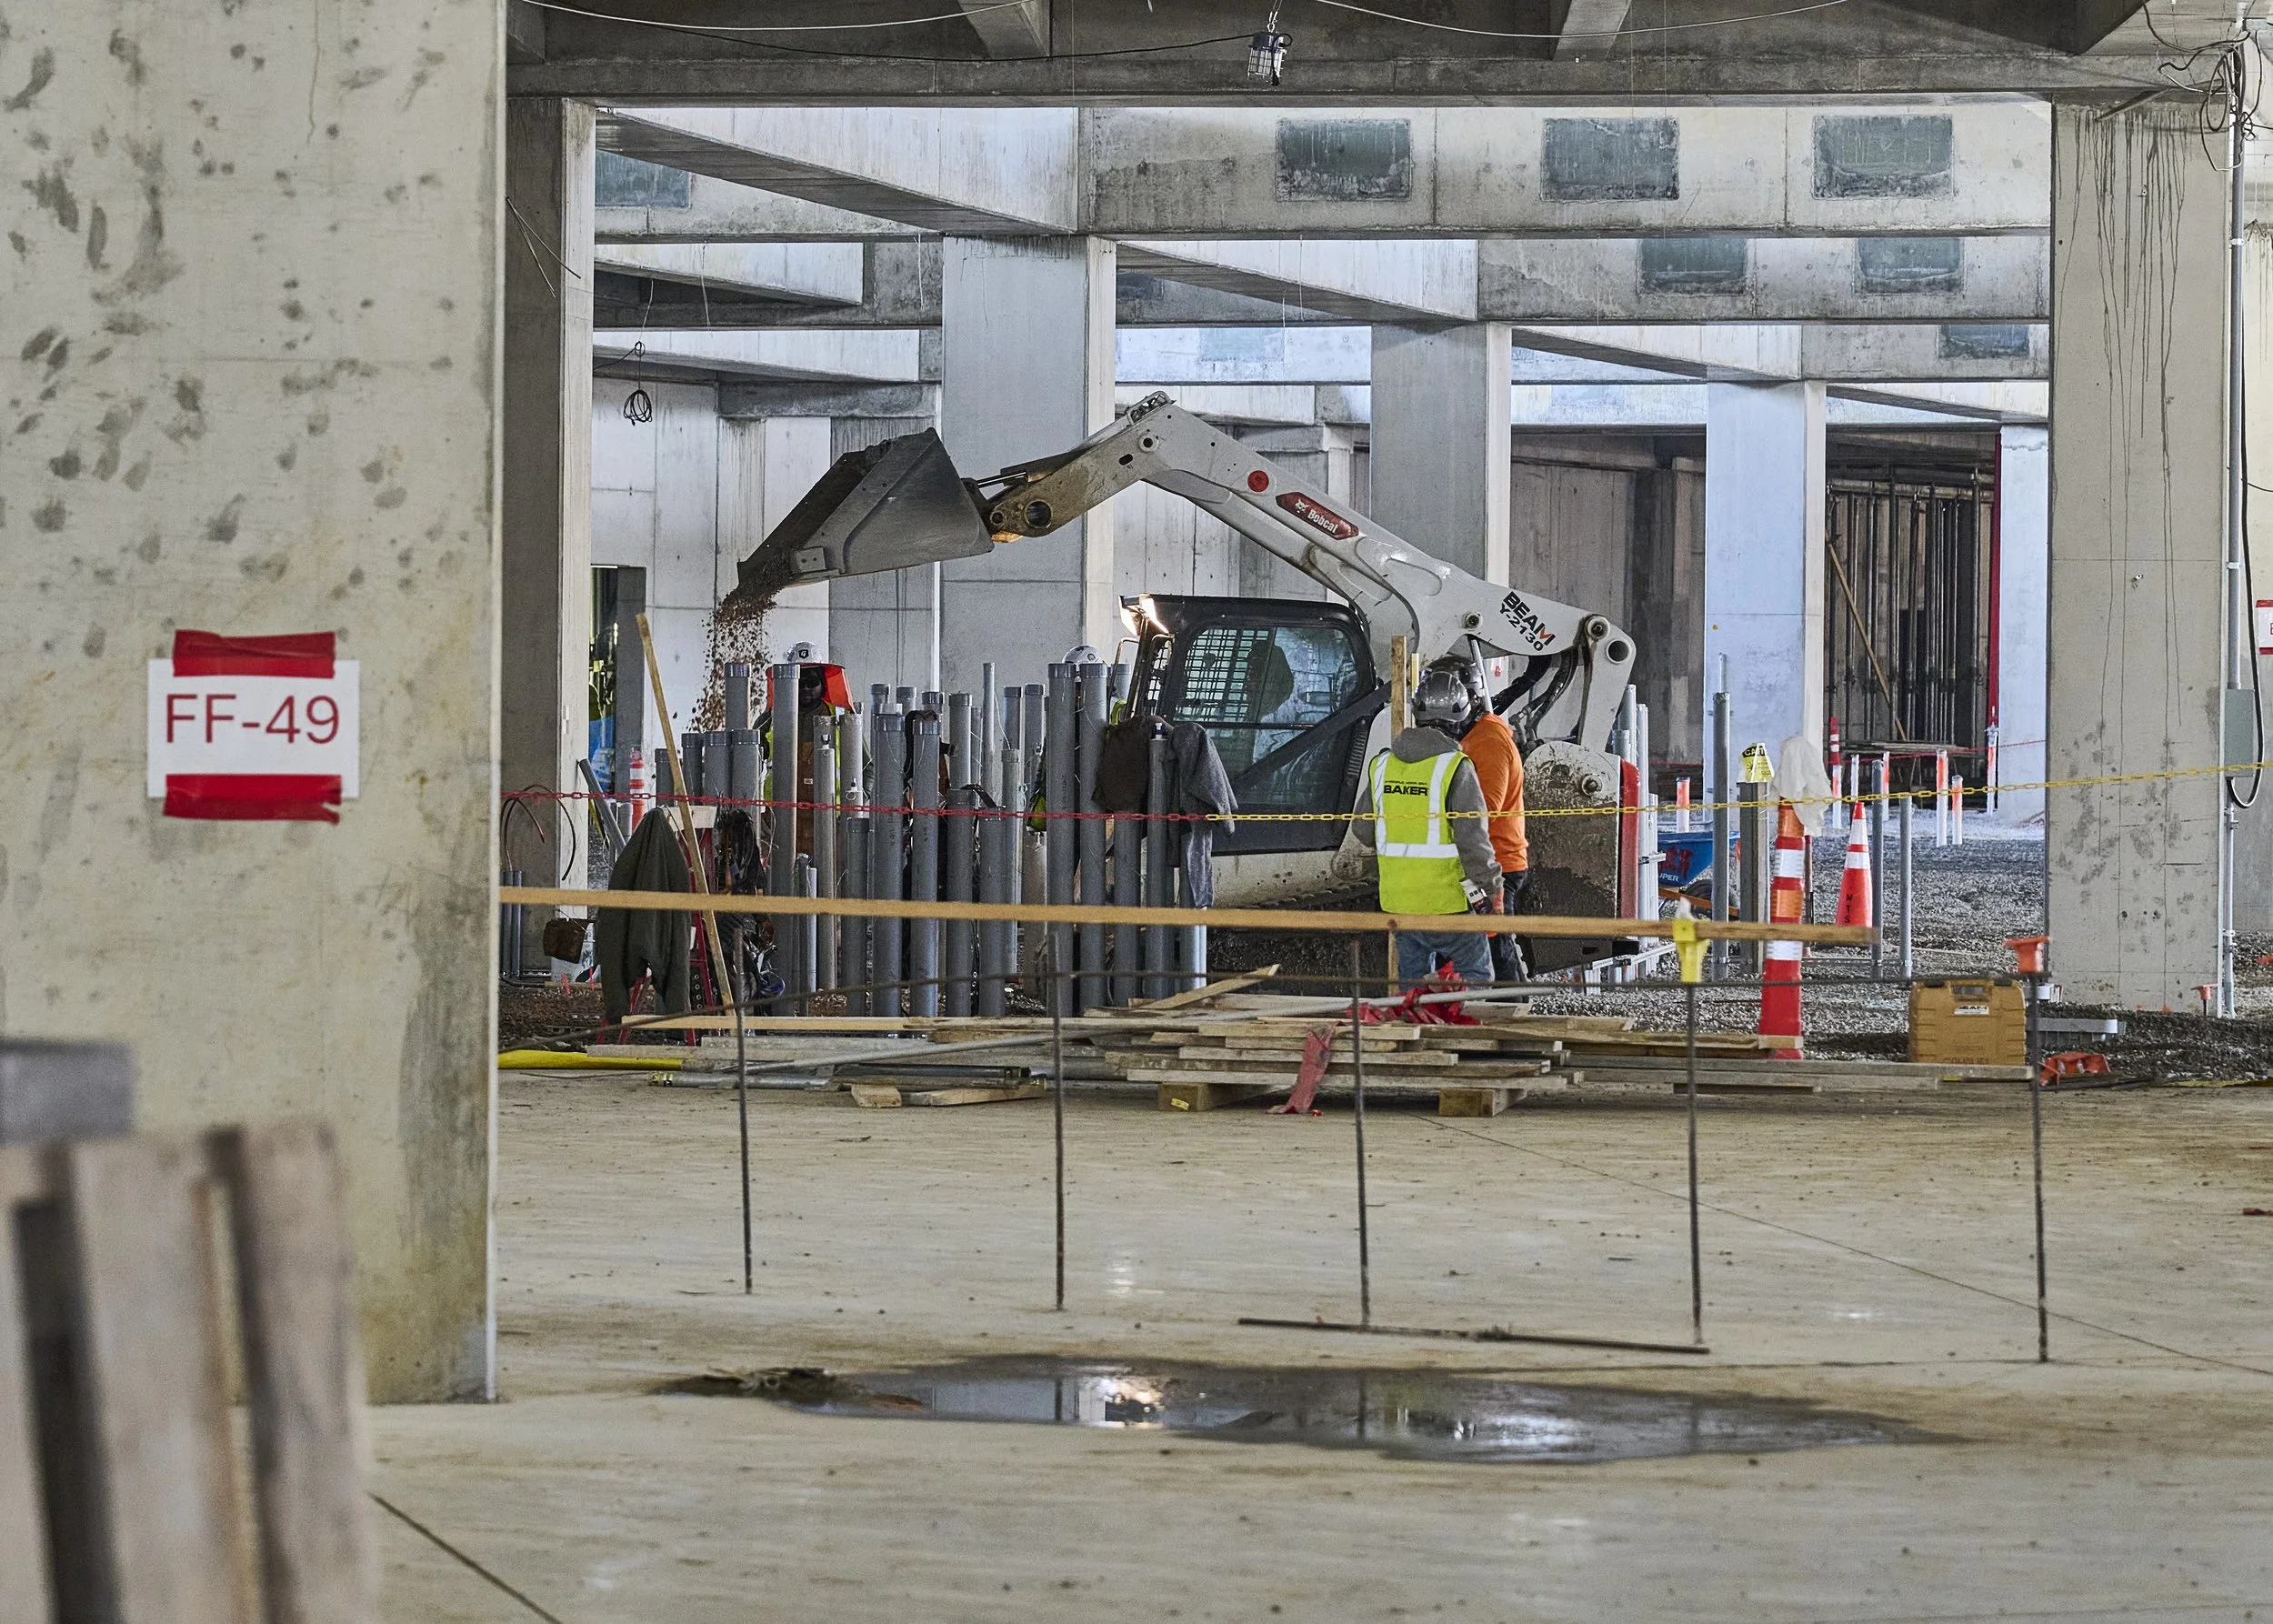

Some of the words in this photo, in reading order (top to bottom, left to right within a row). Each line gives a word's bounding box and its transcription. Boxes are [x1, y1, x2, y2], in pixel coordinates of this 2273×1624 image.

[1307, 509, 1338, 534] Bobcat
[1499, 603, 1544, 651] Y-2130
[1503, 591, 1556, 646] BEAM
[166, 694, 339, 744] FF-49
[1383, 785, 1428, 796] BAKER
